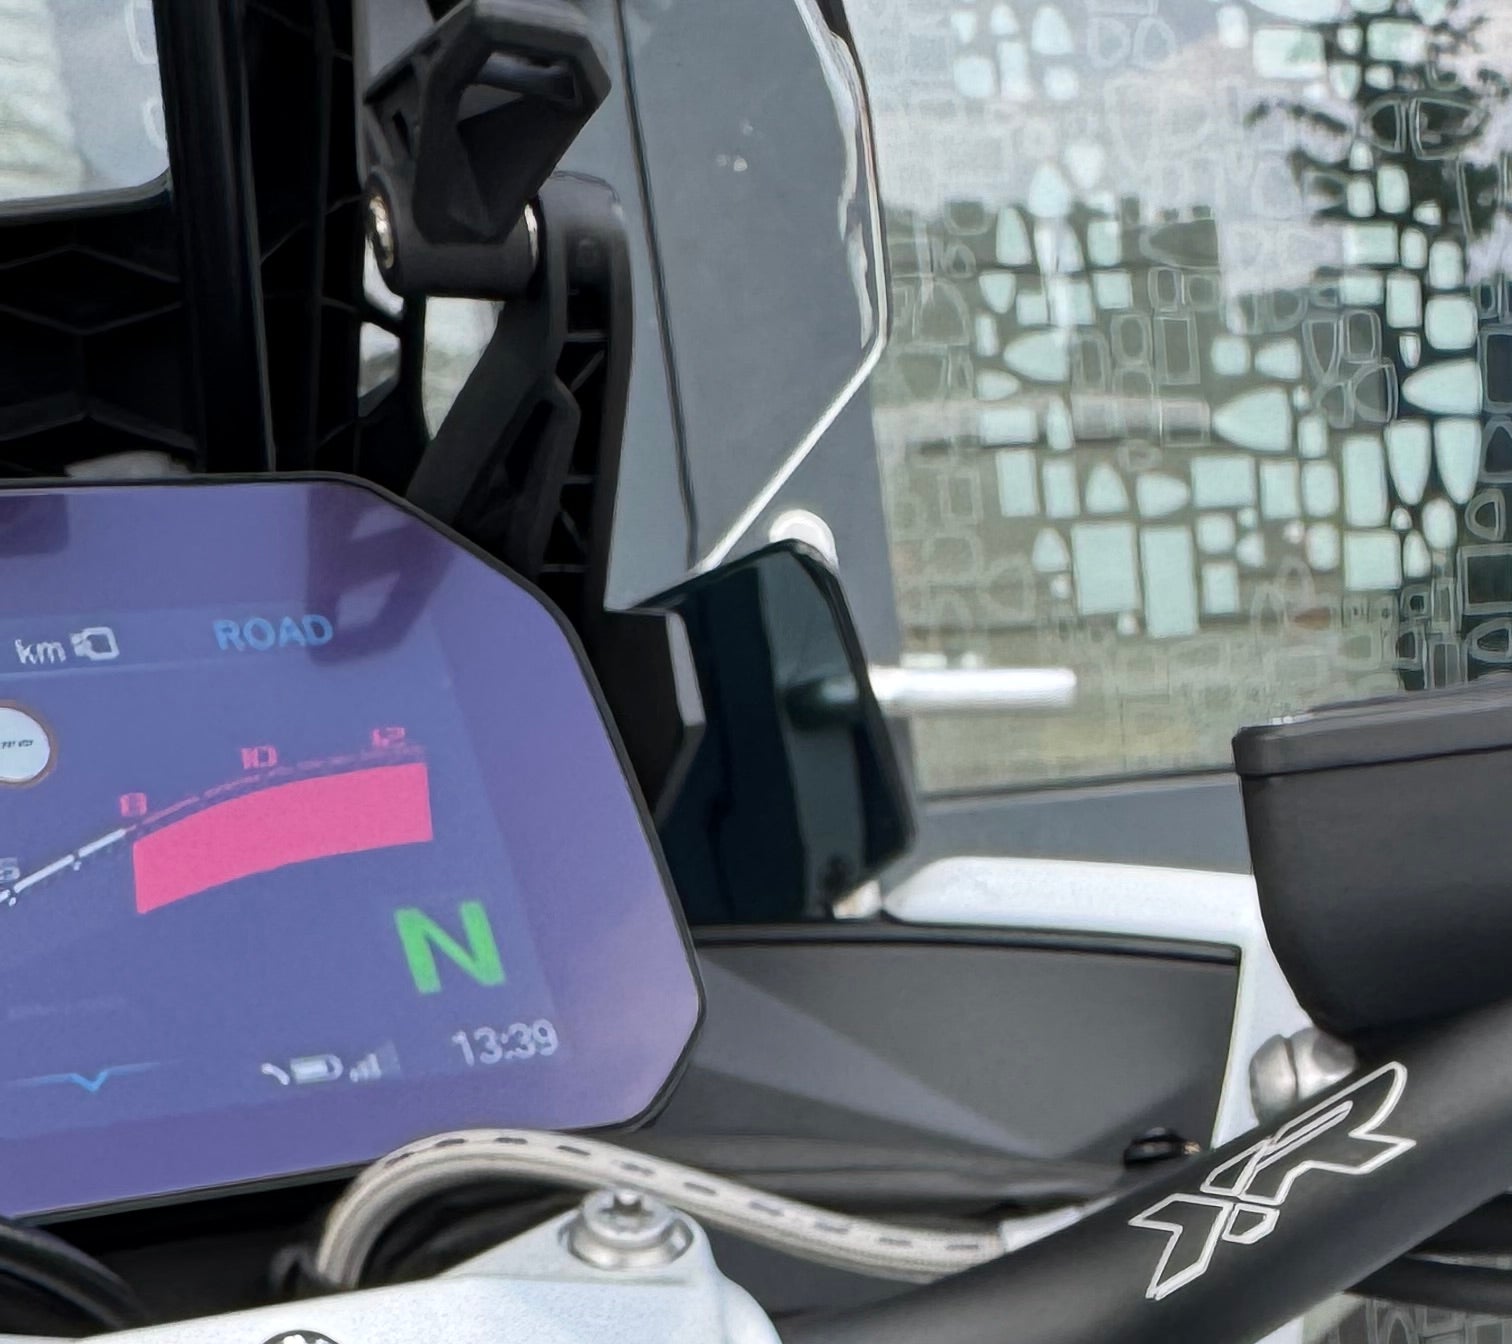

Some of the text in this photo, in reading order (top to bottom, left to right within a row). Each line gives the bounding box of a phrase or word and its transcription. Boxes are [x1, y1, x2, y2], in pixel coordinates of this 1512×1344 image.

[14, 639, 67, 665] km
[213, 614, 334, 652] ROAD
[393, 900, 506, 994] N
[451, 1018, 559, 1067] 13:39
